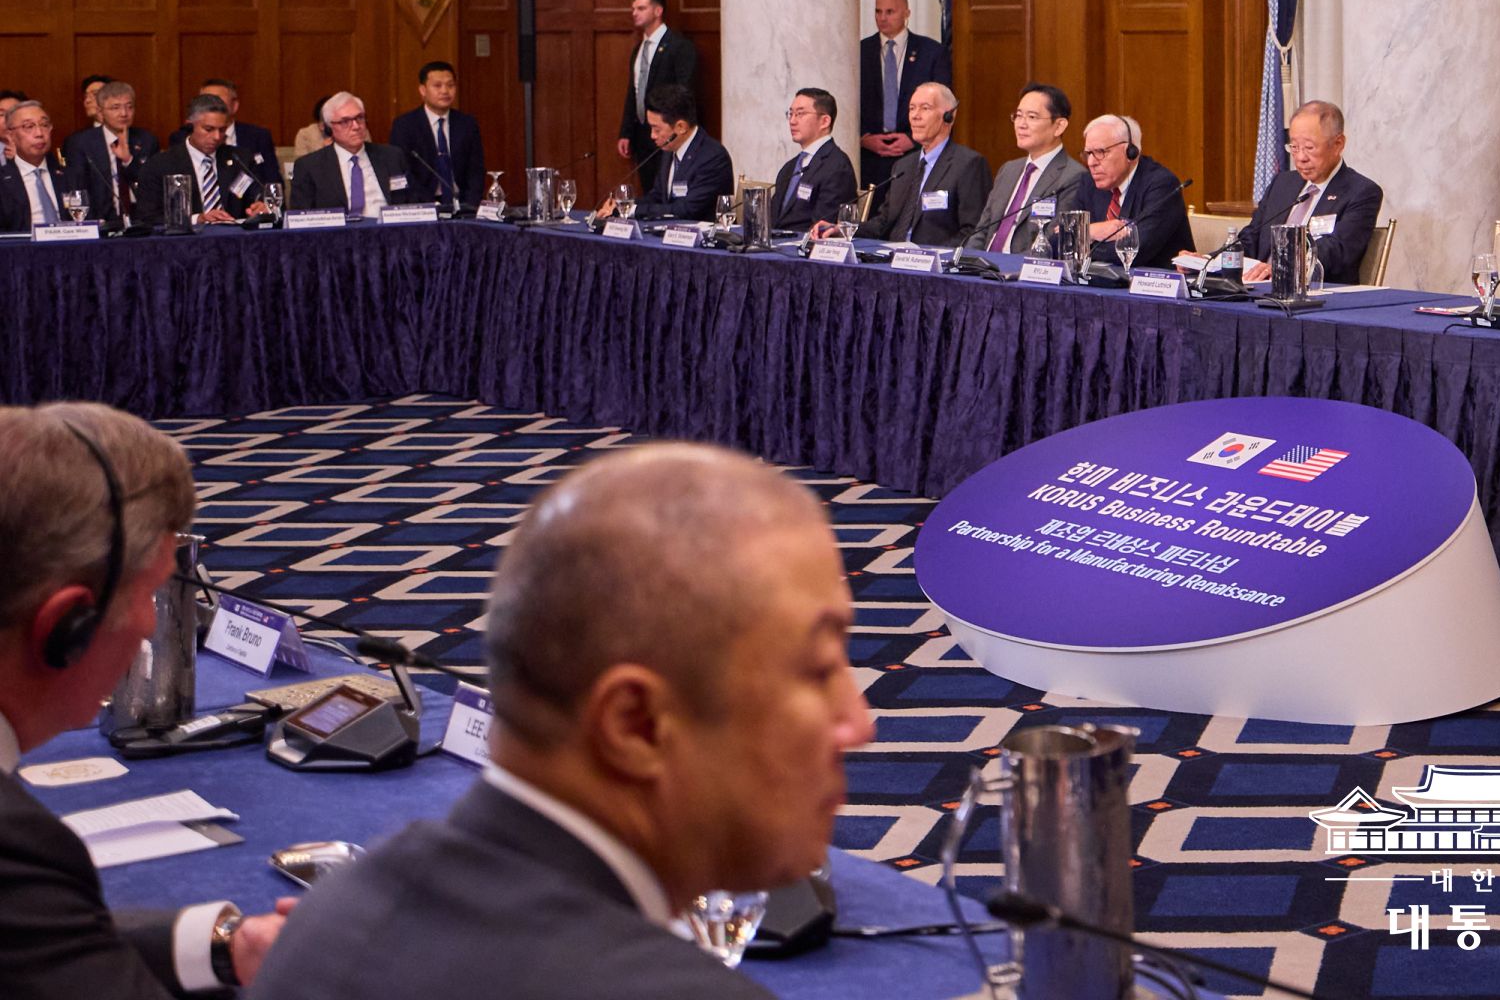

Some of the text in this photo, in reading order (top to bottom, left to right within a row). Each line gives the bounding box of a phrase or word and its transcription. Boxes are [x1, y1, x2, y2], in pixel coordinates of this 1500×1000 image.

[1027, 484, 1328, 558] KORUS Business Roundtable
[1057, 461, 1370, 537] 한미 비즈니스 라운드테이블
[948, 520, 1286, 607] Partnership for a Manufacturing Renaissance
[1035, 519, 1240, 574] 제조업 르네상스 파트너십
[225, 619, 262, 647] Frank Bruno
[465, 717, 485, 738] LEE
